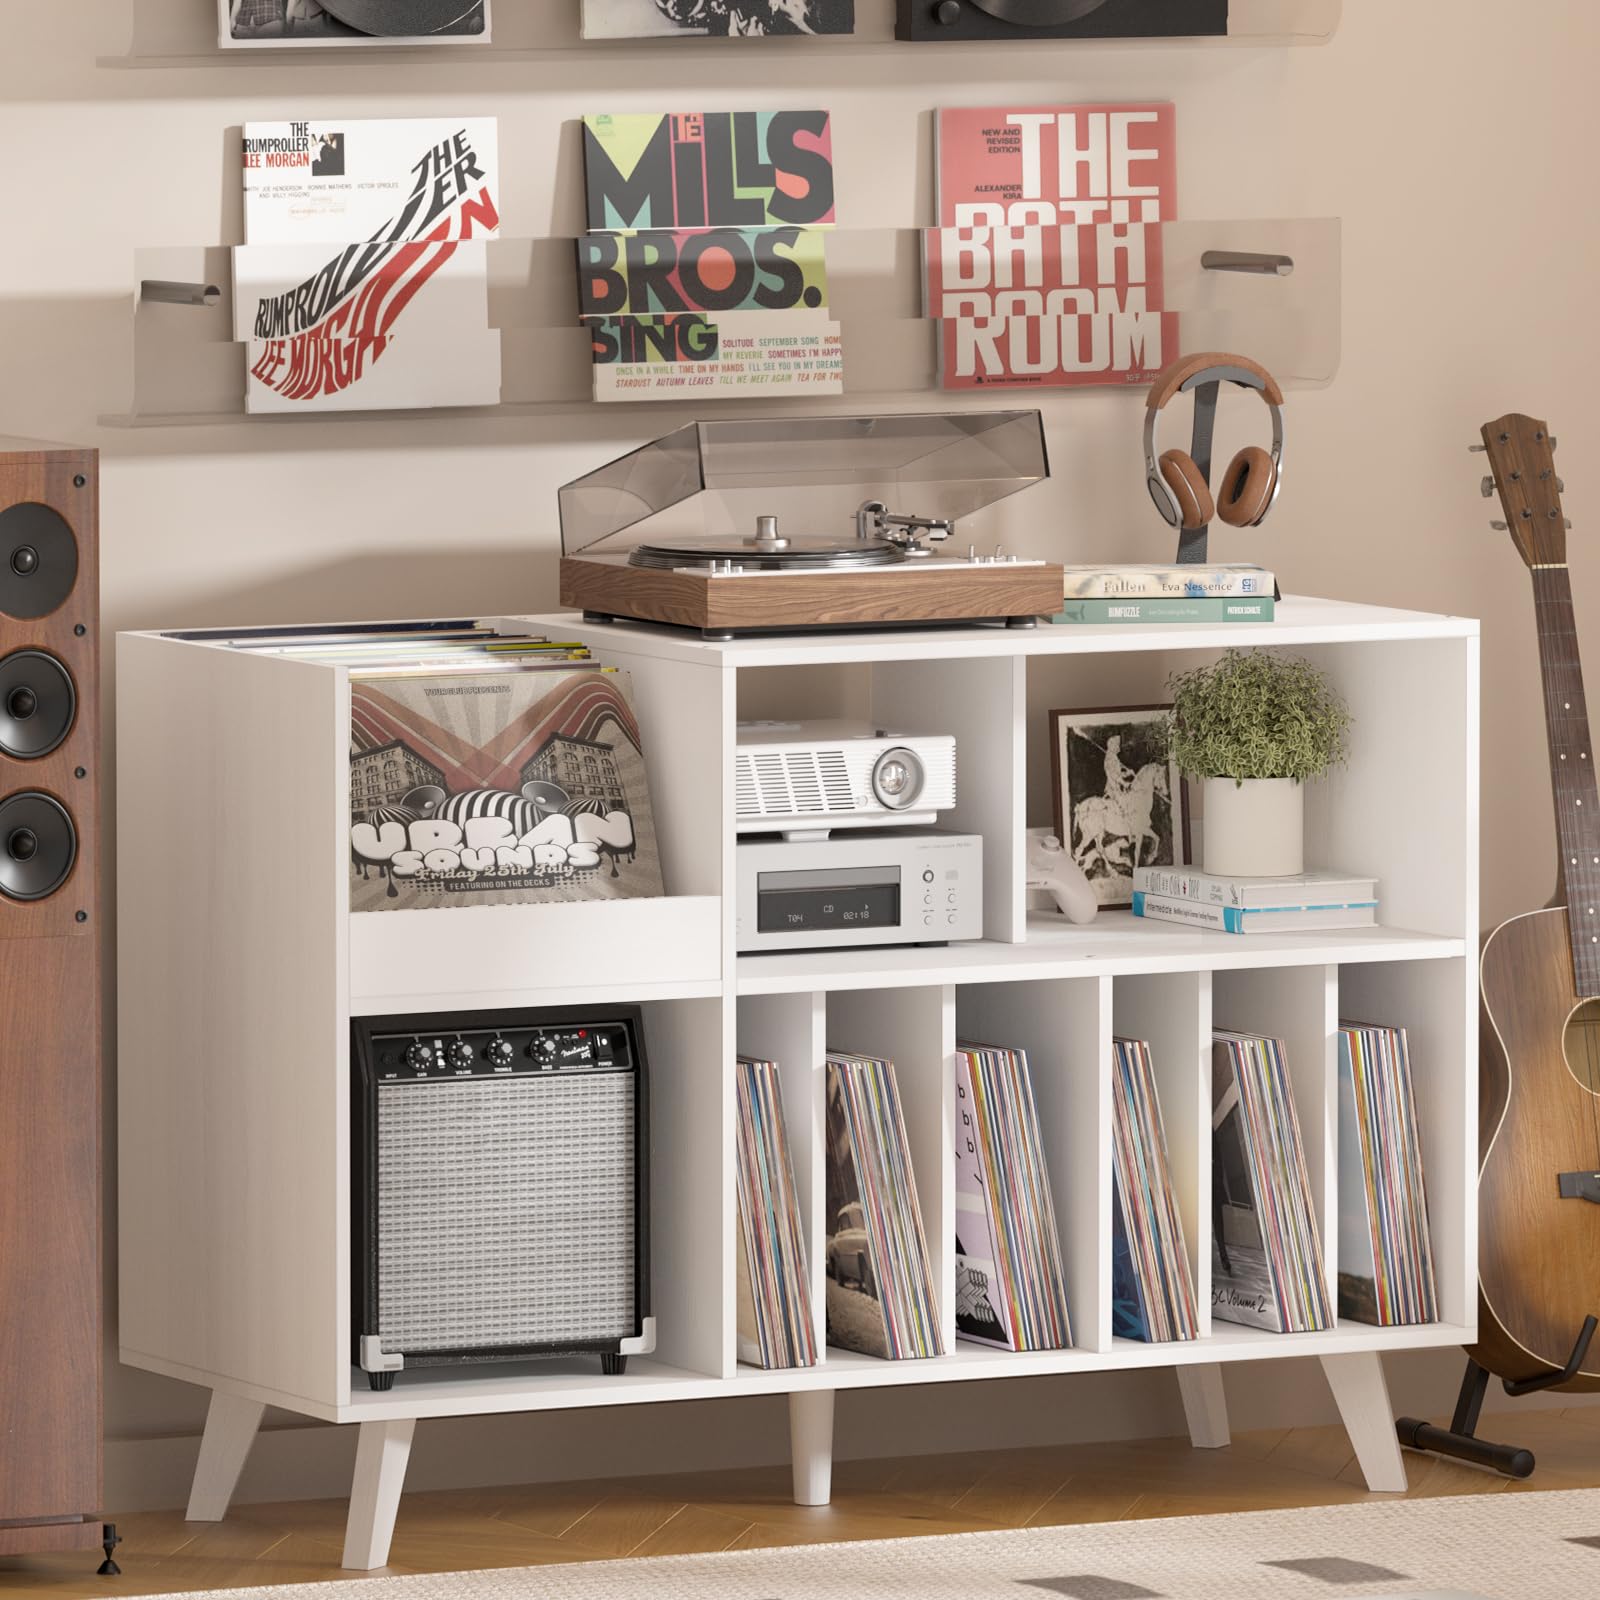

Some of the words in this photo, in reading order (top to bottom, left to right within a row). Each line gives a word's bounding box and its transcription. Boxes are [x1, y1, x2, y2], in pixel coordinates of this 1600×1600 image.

[290, 122, 309, 136] THE
[1002, 128, 1020, 136] AND
[243, 138, 309, 152] RUMPROLLER
[243, 153, 261, 168] LEE
[266, 152, 310, 168] MORGAN
[1006, 112, 1159, 199] THE
[583, 110, 834, 229] MILLS
[975, 184, 1022, 192] ALEXANDER
[941, 200, 1159, 289] BATH
[578, 226, 822, 315] BROS.
[584, 313, 718, 363] SING
[942, 286, 1162, 376] ROOM
[722, 338, 754, 348] SOLITUDE
[759, 337, 798, 347] SEPTEMBER
[801, 336, 819, 345] SONG
[736, 351, 763, 359] REVERIE
[768, 350, 806, 359] SOMETIMES
[809, 349, 819, 357] I'M
[616, 367, 633, 375] ONCE
[646, 366, 651, 374] A
[654, 366, 674, 374] WHILE
[680, 365, 695, 374] TIME
[698, 365, 706, 373] ON
[709, 364, 718, 372] MY
[722, 364, 744, 372] HANDS
[764, 362, 775, 370] SEE
[779, 362, 791, 370] YOU
[794, 362, 801, 370] IN
[804, 361, 813, 369] MY
[616, 378, 651, 388] STARDUST
[656, 378, 685, 386] AUTUMN
[688, 377, 714, 385] LEAVES
[720, 376, 733, 384] TILL
[737, 375, 747, 384] WE
[750, 374, 769, 383] MEET
[772, 374, 792, 383] AGAIN
[797, 373, 810, 382] TEA
[813, 372, 826, 381] FOR
[1104, 580, 1145, 593] Fallen
[1184, 583, 1232, 591] Nessence
[352, 811, 634, 860] URBAN
[391, 842, 601, 876] SOUNDS
[414, 866, 478, 881] Friday
[484, 864, 529, 876] 25th
[534, 862, 576, 877] July
[450, 881, 494, 890] FEATURING
[495, 880, 505, 888] ON
[507, 880, 522, 888] THE
[1226, 1288, 1256, 1310] Volume
[1258, 1295, 1266, 1312] 2
